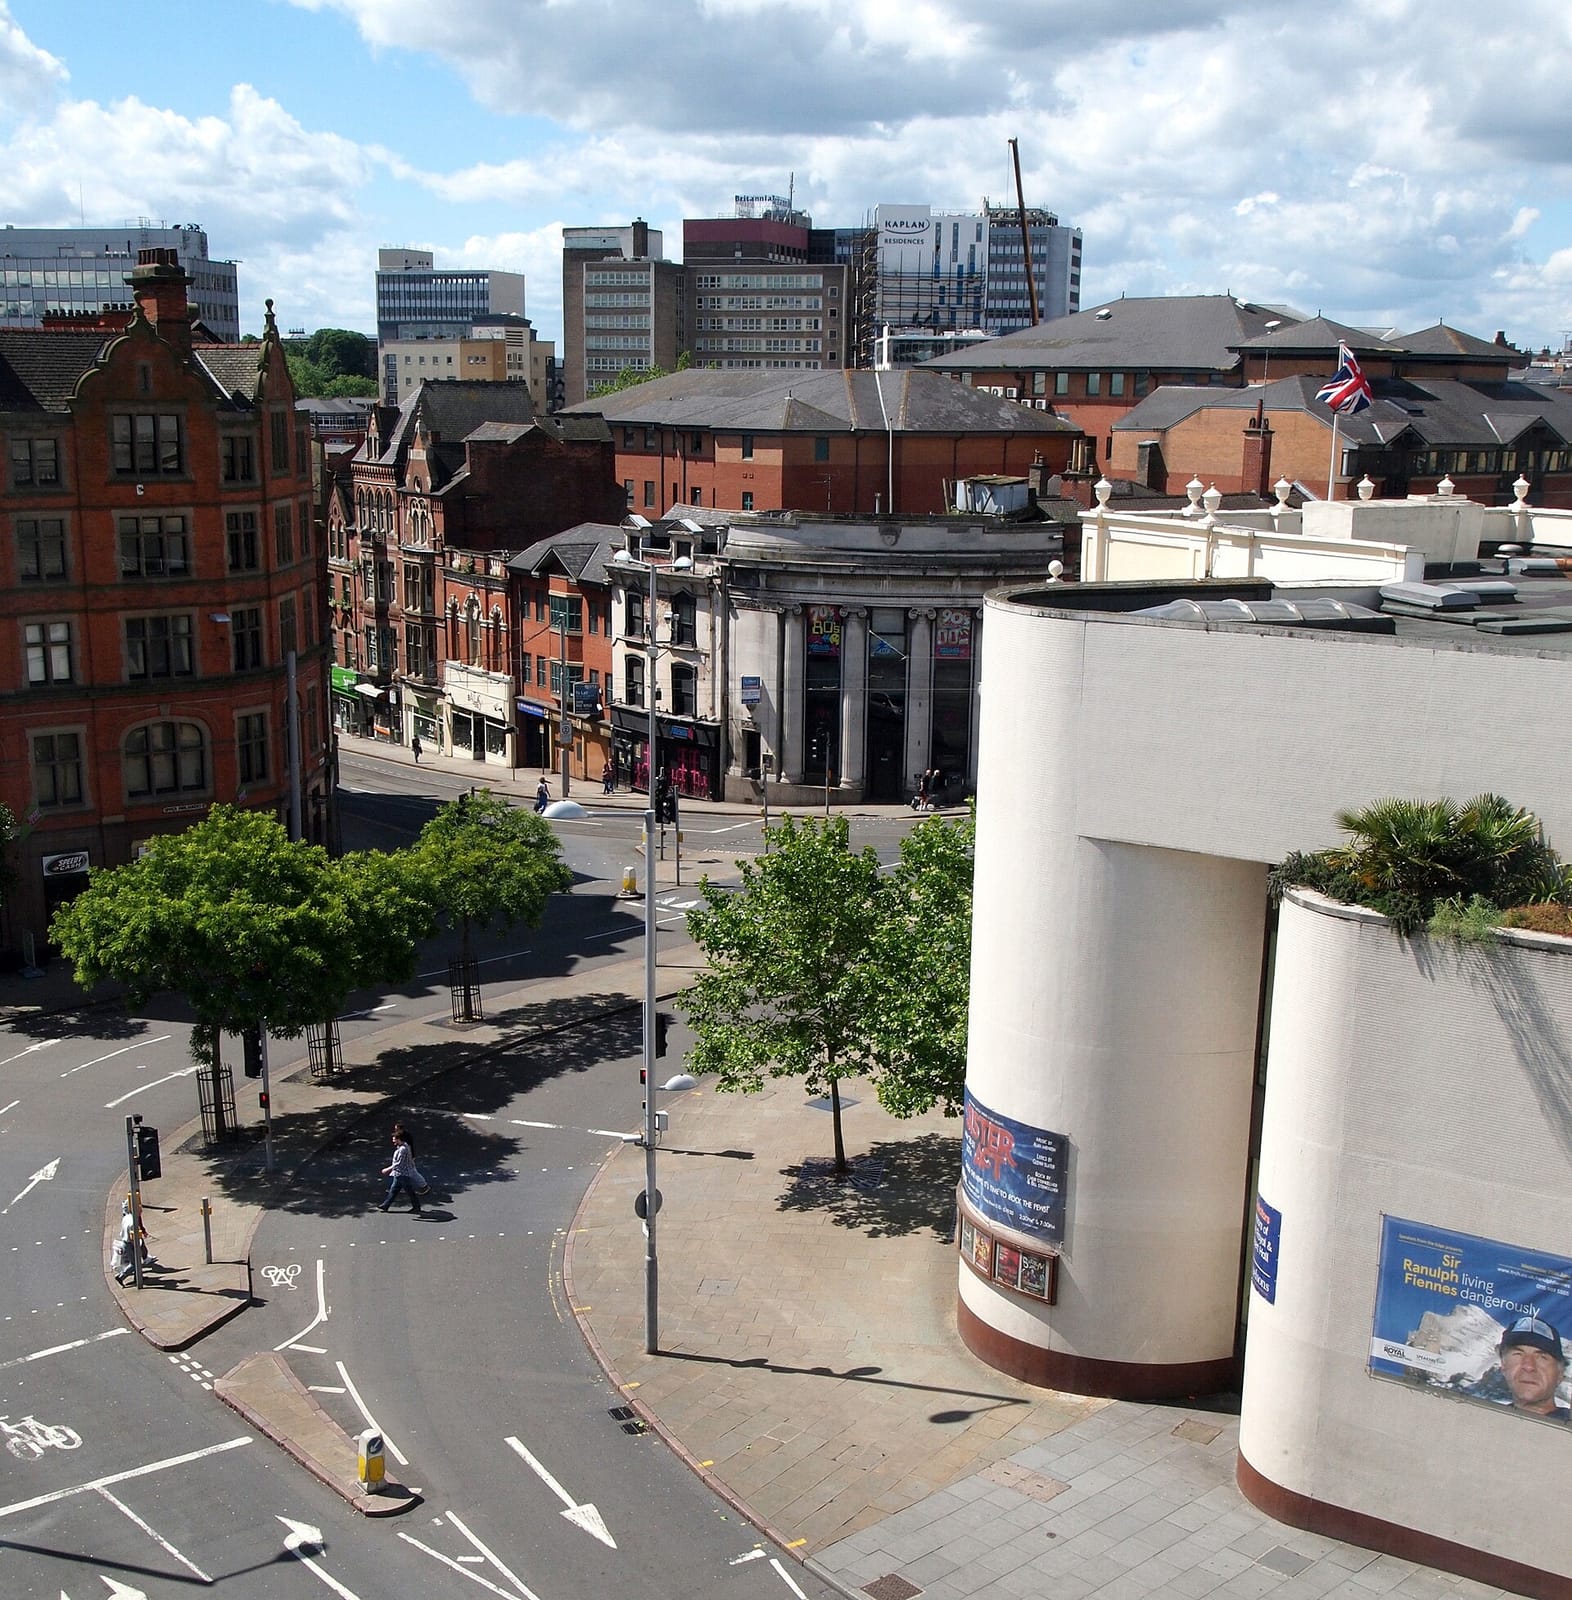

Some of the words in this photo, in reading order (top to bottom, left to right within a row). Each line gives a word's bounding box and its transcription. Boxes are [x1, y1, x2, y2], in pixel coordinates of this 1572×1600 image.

[885, 220, 925, 228] KAPLAN
[812, 621, 841, 634] 80's
[58, 855, 83, 867] SPEEDY
[60, 862, 82, 872] CASH
[1007, 1192, 1021, 1205] ROCK
[1022, 1198, 1033, 1209] THE
[1442, 1254, 1462, 1269] Sir
[1403, 1258, 1459, 1284] Ranulph
[1404, 1272, 1458, 1296] Fiennes
[1461, 1272, 1494, 1296] living
[1460, 1288, 1541, 1319] dangerously
[1383, 1346, 1406, 1358] ROYAL
